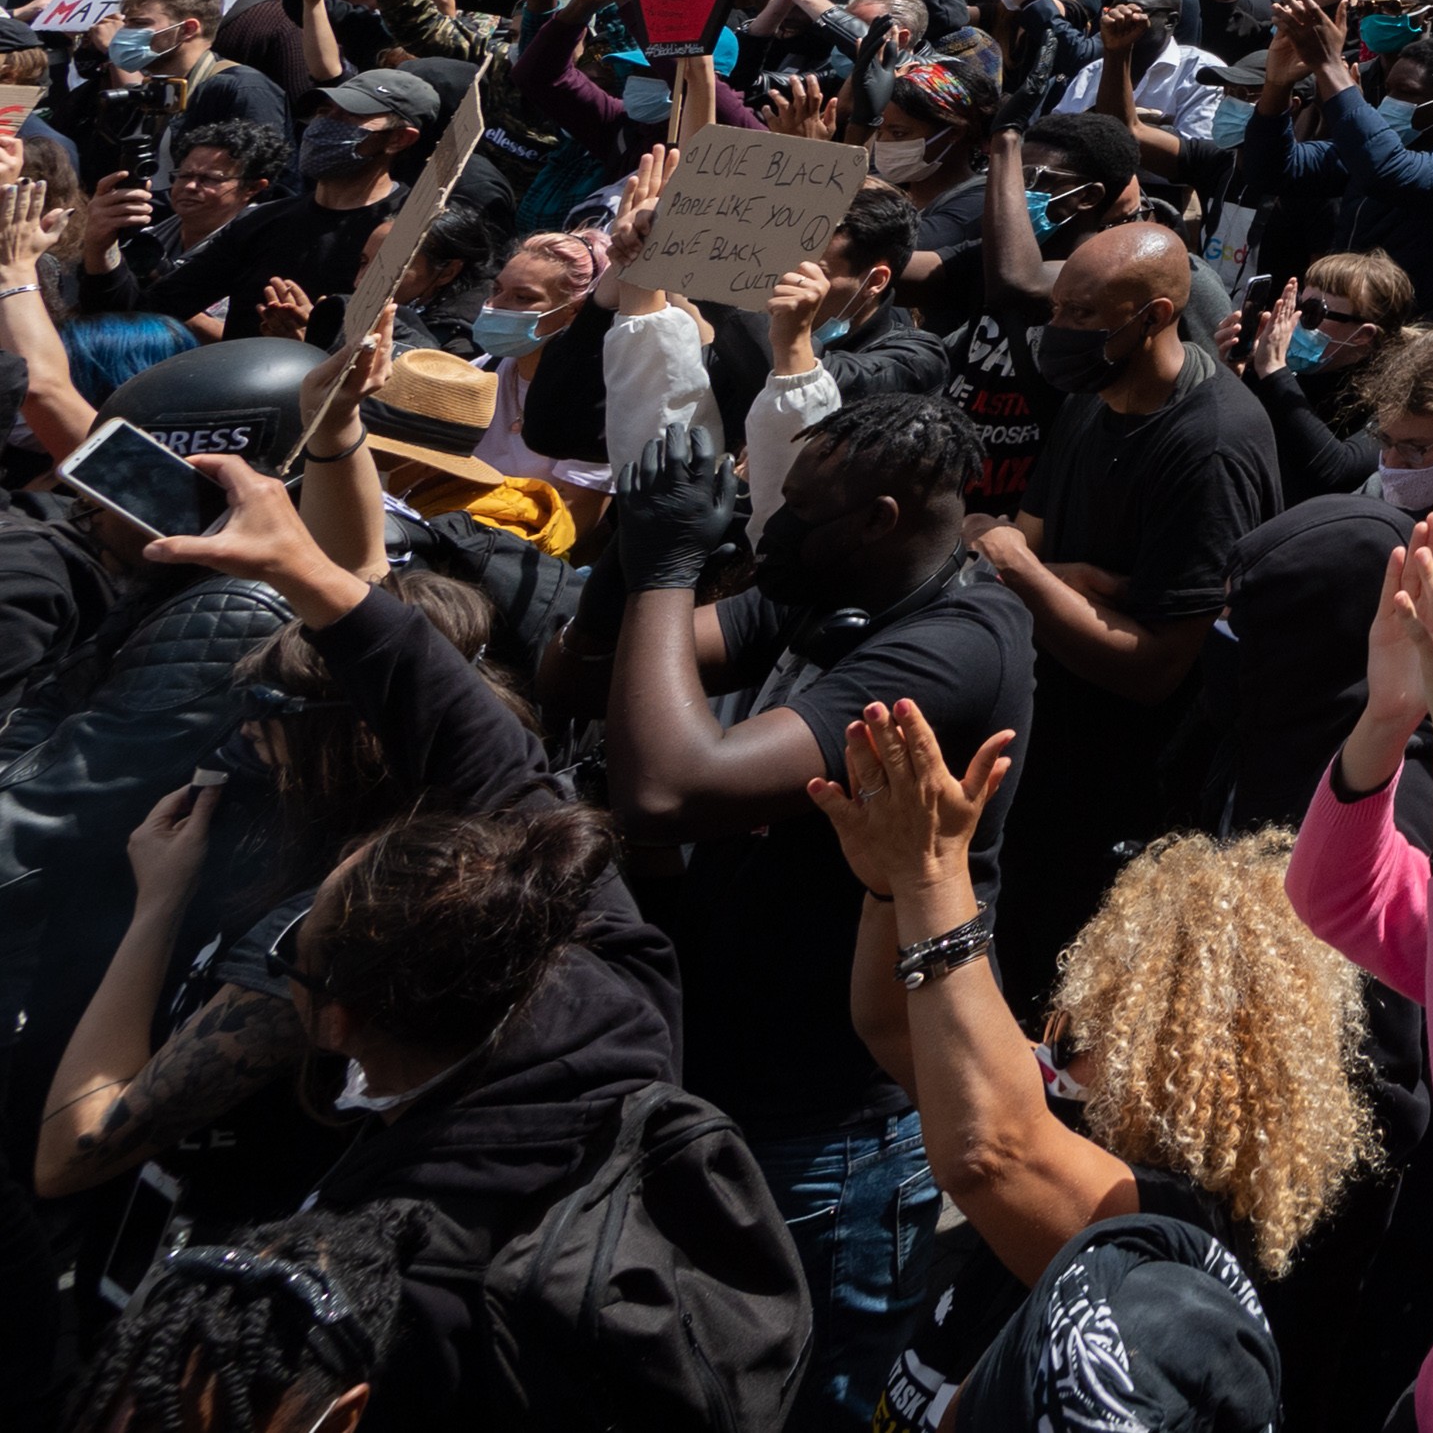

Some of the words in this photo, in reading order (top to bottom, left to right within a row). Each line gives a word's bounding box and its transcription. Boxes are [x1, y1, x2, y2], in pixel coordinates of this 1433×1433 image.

[485, 127, 539, 160] ellesse
[696, 143, 763, 179] LOVE
[762, 150, 845, 195] BLACK
[667, 191, 716, 217] PEOPLE
[760, 204, 806, 230] YOU
[709, 236, 768, 268] BLACK
[149, 426, 252, 455] PRESS
